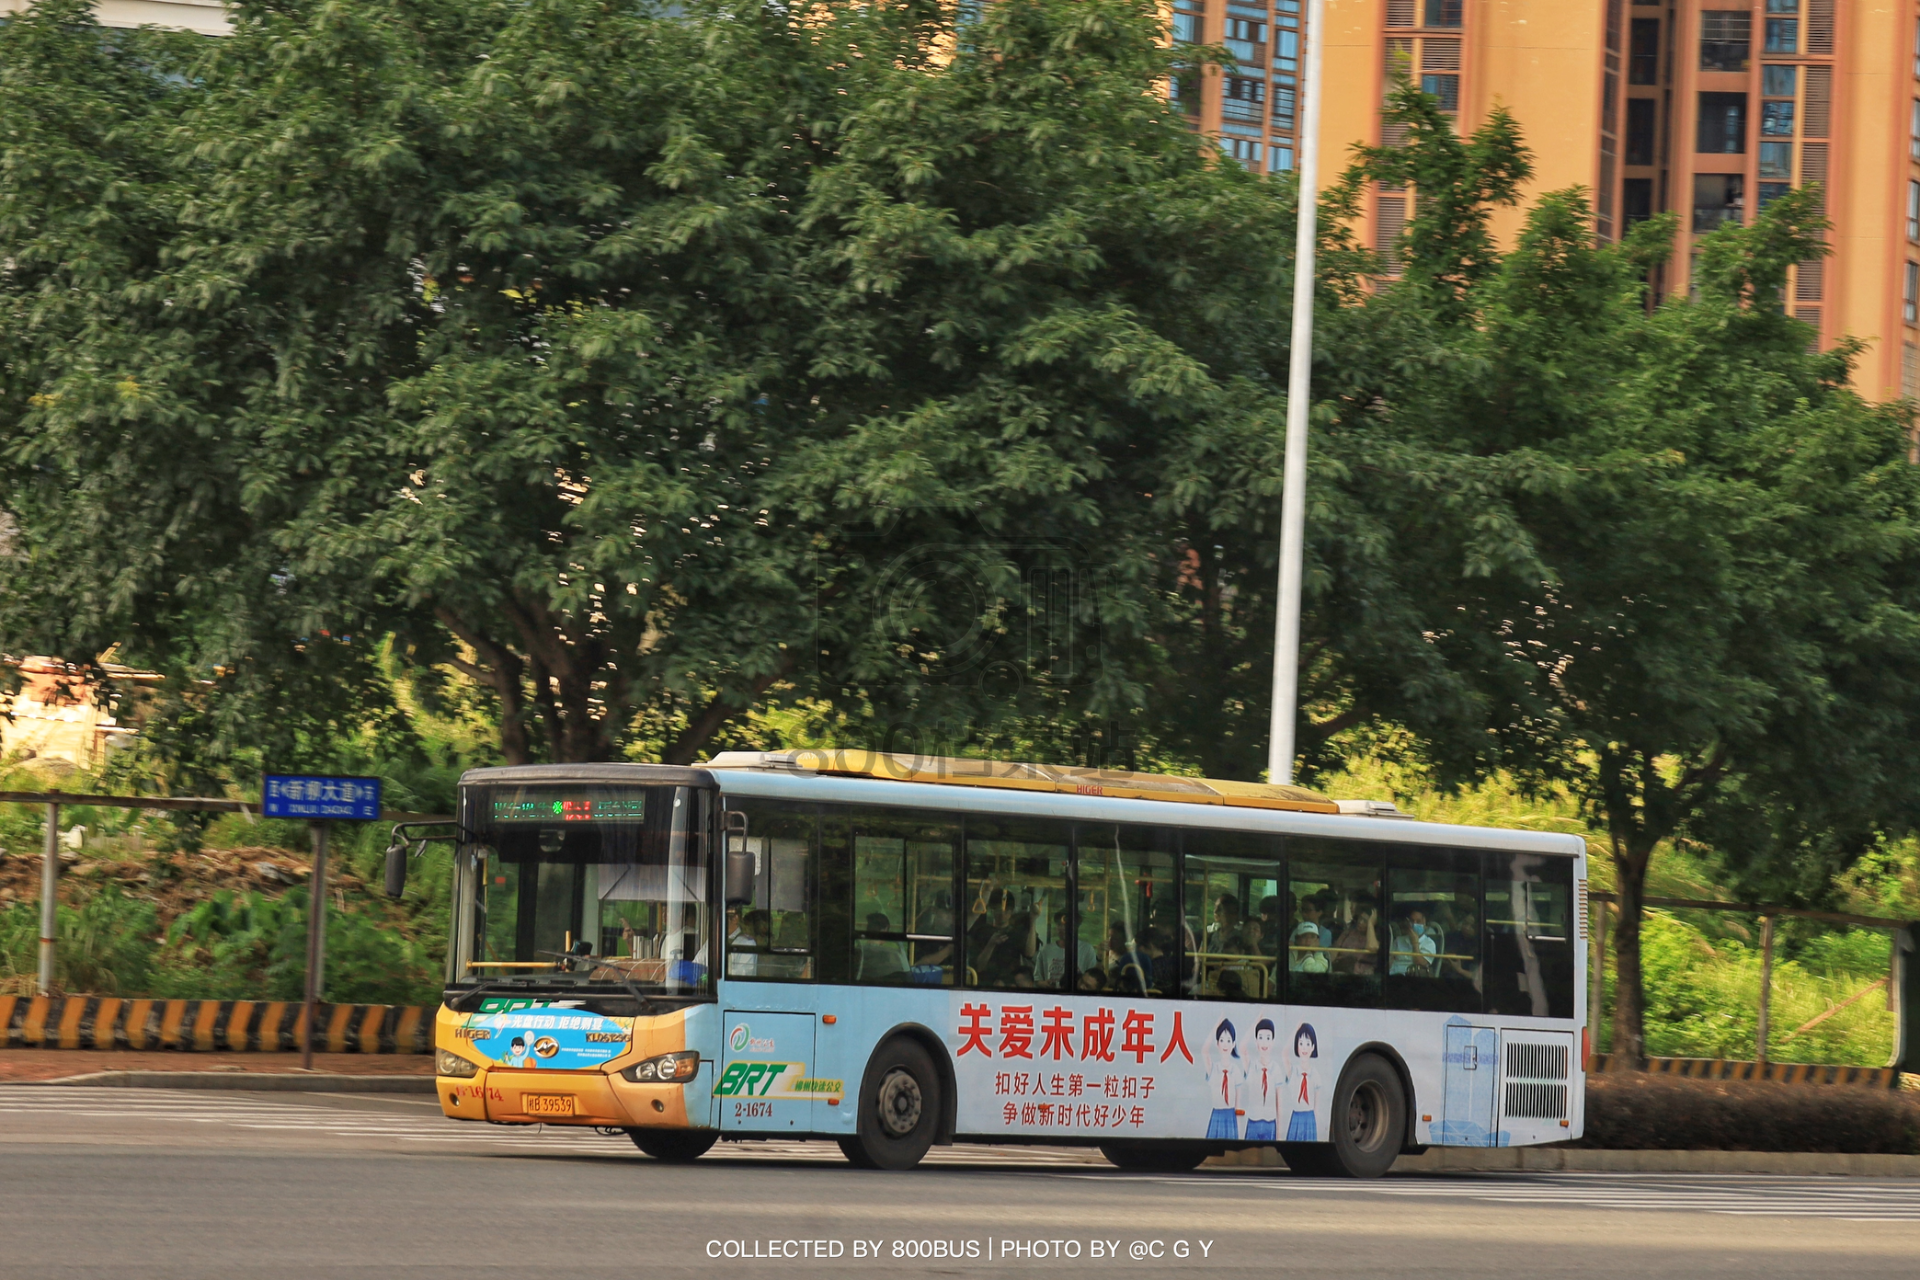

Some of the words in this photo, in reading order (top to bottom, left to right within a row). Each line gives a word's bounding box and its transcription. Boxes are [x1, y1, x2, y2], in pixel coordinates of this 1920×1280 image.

[1076, 784, 1104, 796] HIGER
[511, 1015, 556, 1030] 光盘行动
[455, 1028, 491, 1041] HIGER
[956, 1002, 1195, 1066] 关爱未成年人
[713, 1062, 789, 1096] BRT
[994, 1070, 1156, 1101] 扣好人生第一粒扣子
[734, 1102, 773, 1118] 2-1674
[1002, 1101, 1146, 1129] 争做新时代好少年
